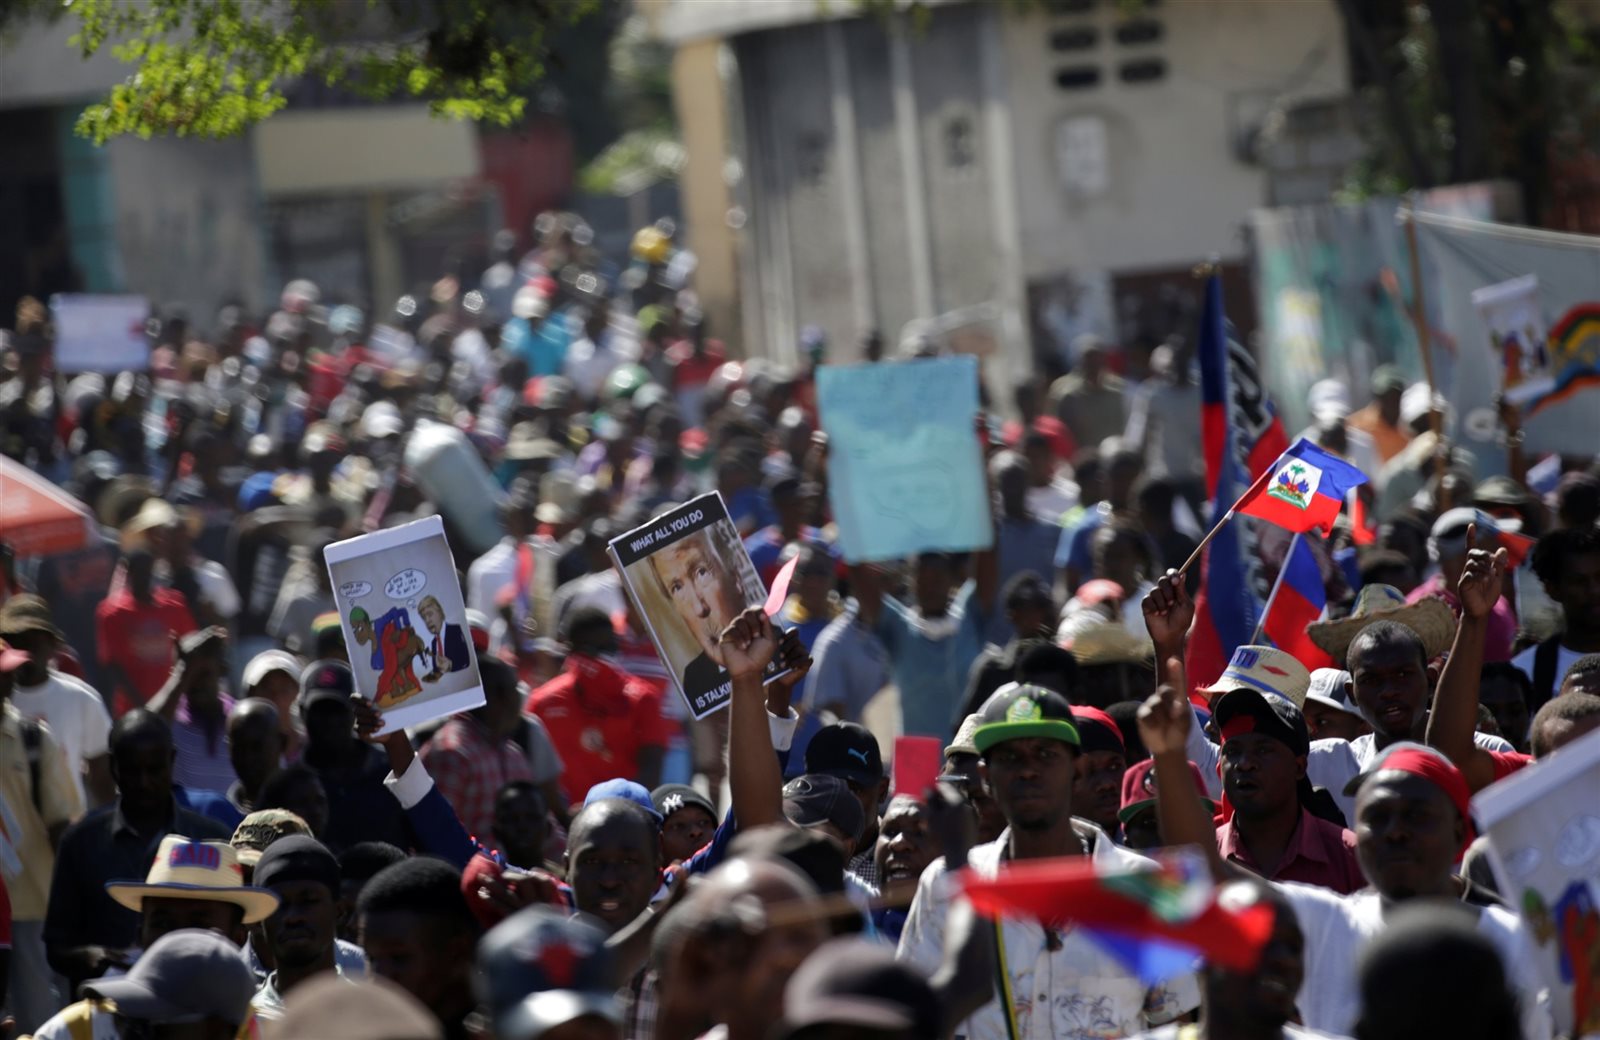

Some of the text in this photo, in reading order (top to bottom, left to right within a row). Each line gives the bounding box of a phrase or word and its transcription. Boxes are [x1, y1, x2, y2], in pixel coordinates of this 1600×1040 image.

[630, 509, 704, 553] WHAT ALL YOU DO
[695, 681, 732, 709] IS TALKI
